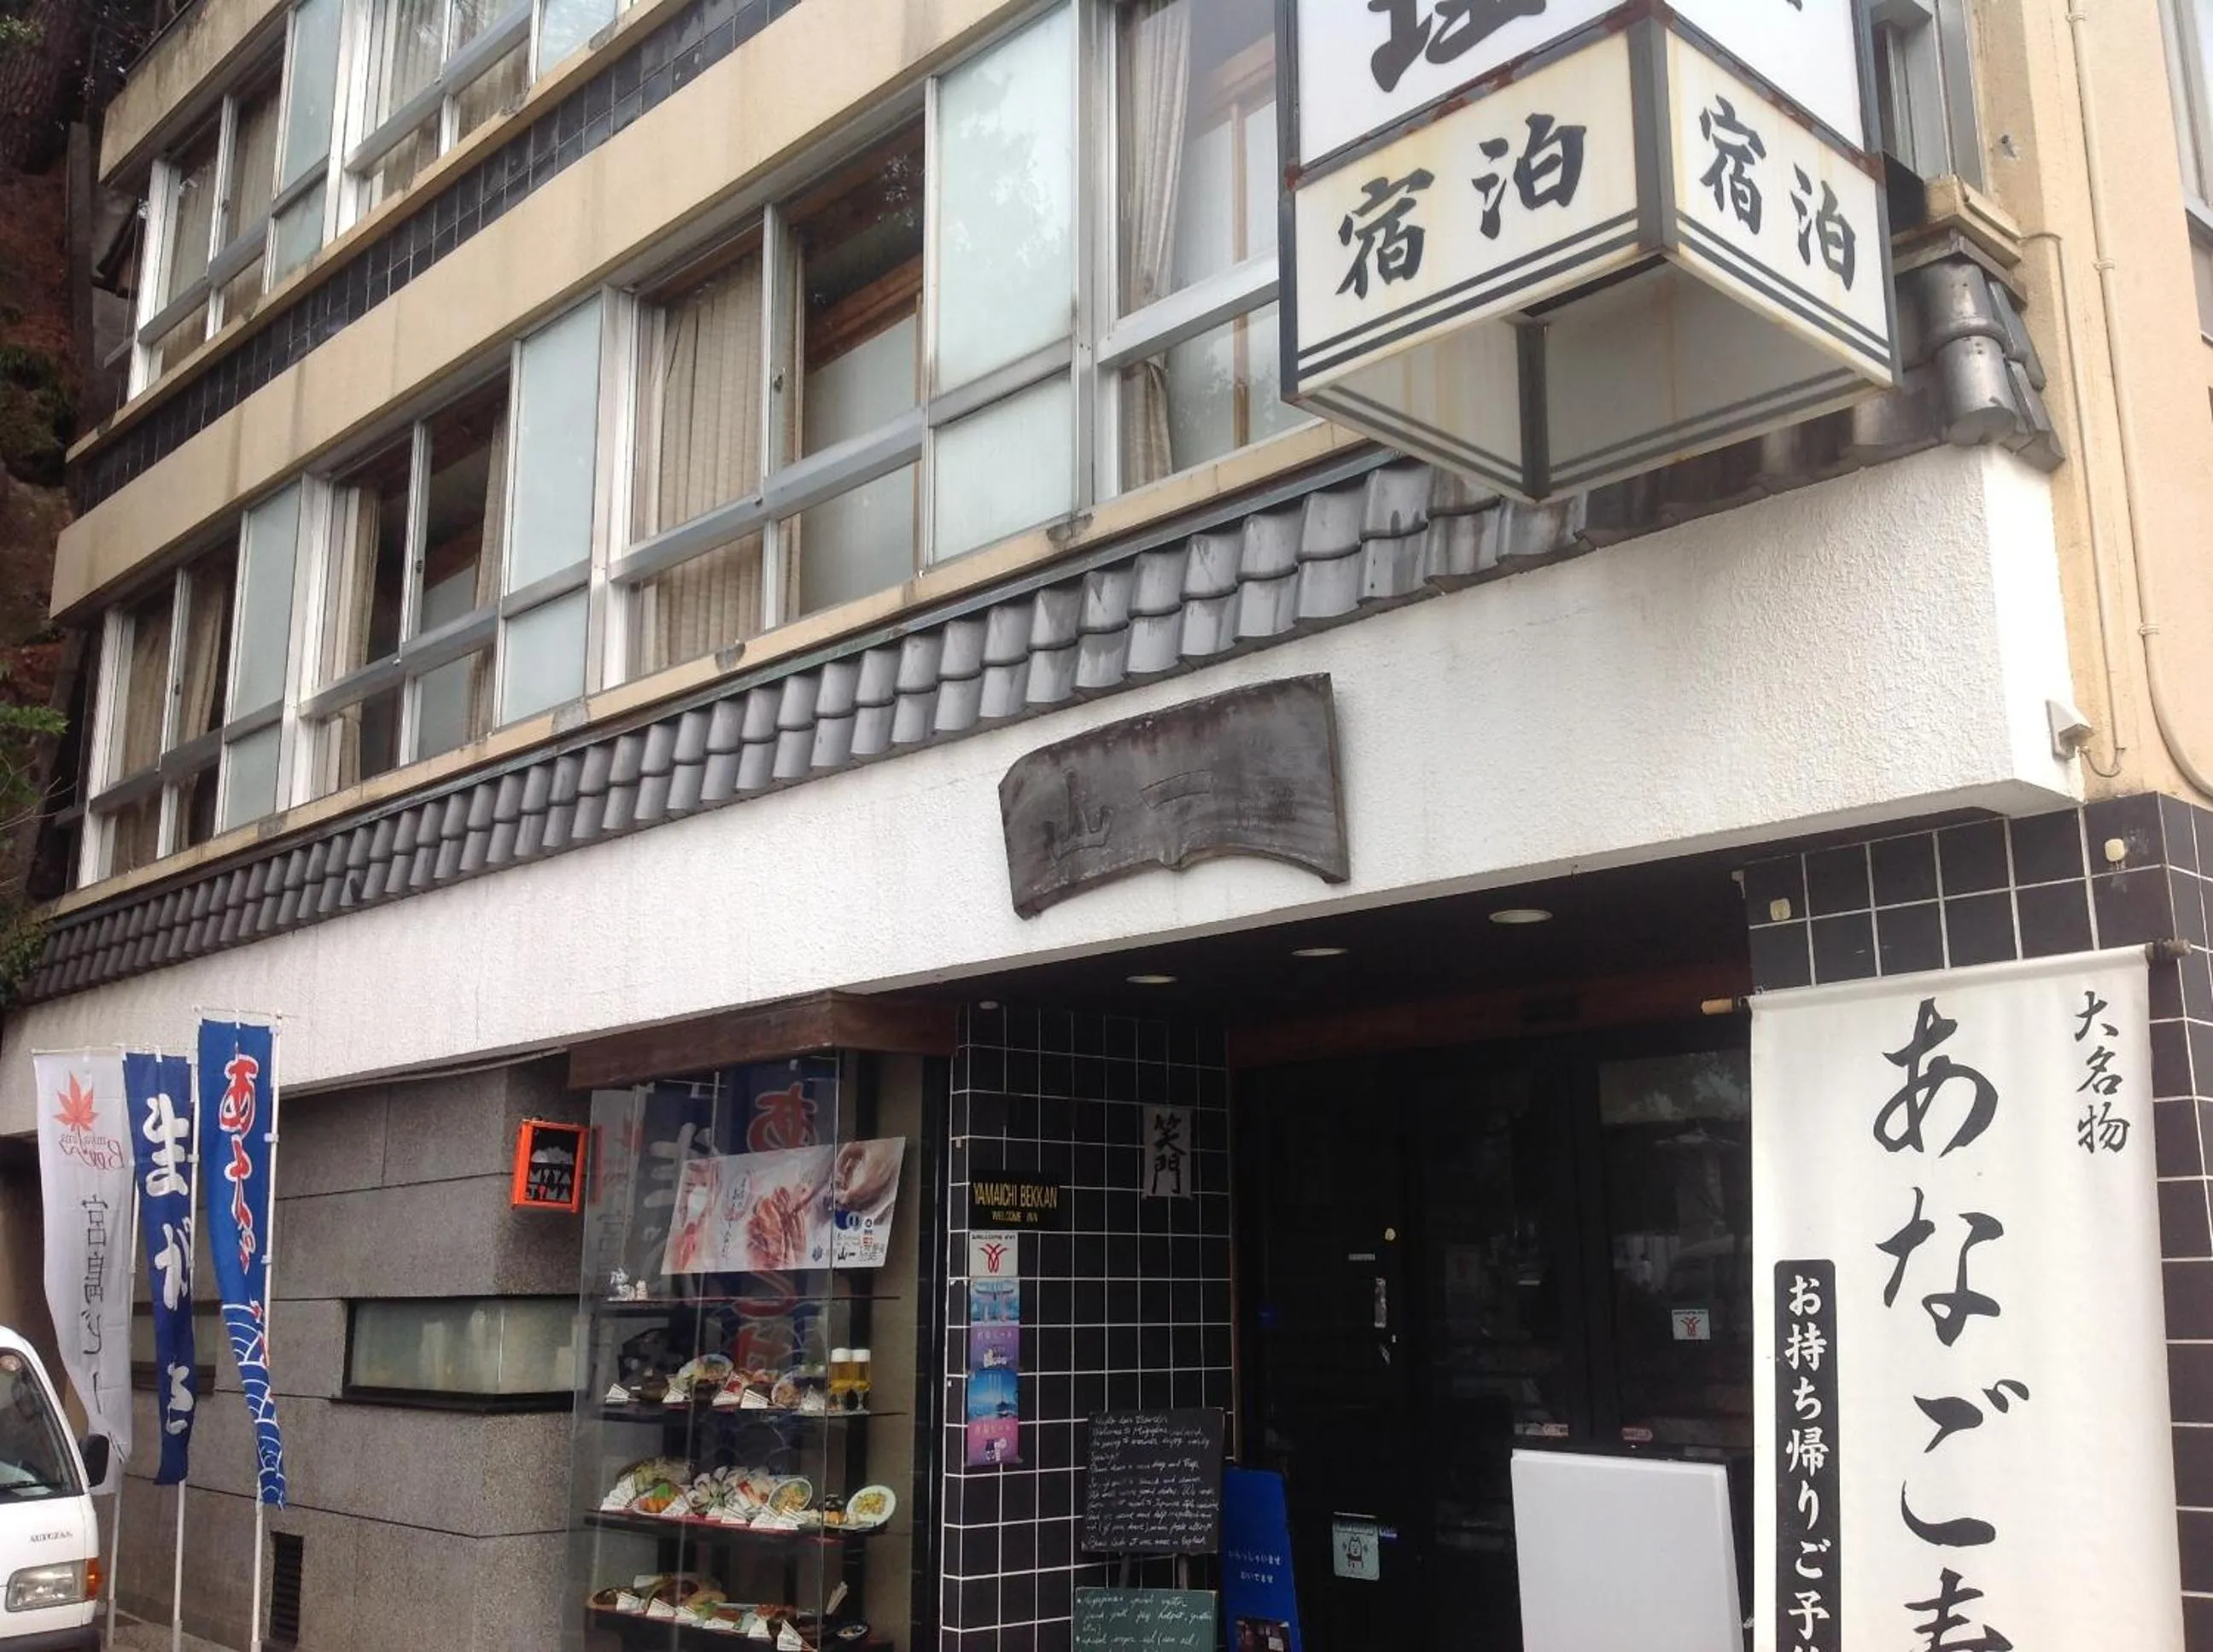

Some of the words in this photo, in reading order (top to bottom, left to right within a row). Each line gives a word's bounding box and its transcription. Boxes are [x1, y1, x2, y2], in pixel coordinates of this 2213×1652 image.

[1334, 113, 1587, 300] 宿泊
[1700, 94, 1856, 293] 宿泊
[1151, 1112, 1188, 1195] 笑門
[2074, 989, 2132, 1154] 大名物
[973, 1182, 1018, 1206] YAMAICHI
[1020, 1184, 1058, 1209] BEKKAN
[1783, 1275, 1832, 1652] お持ち帰りご予
